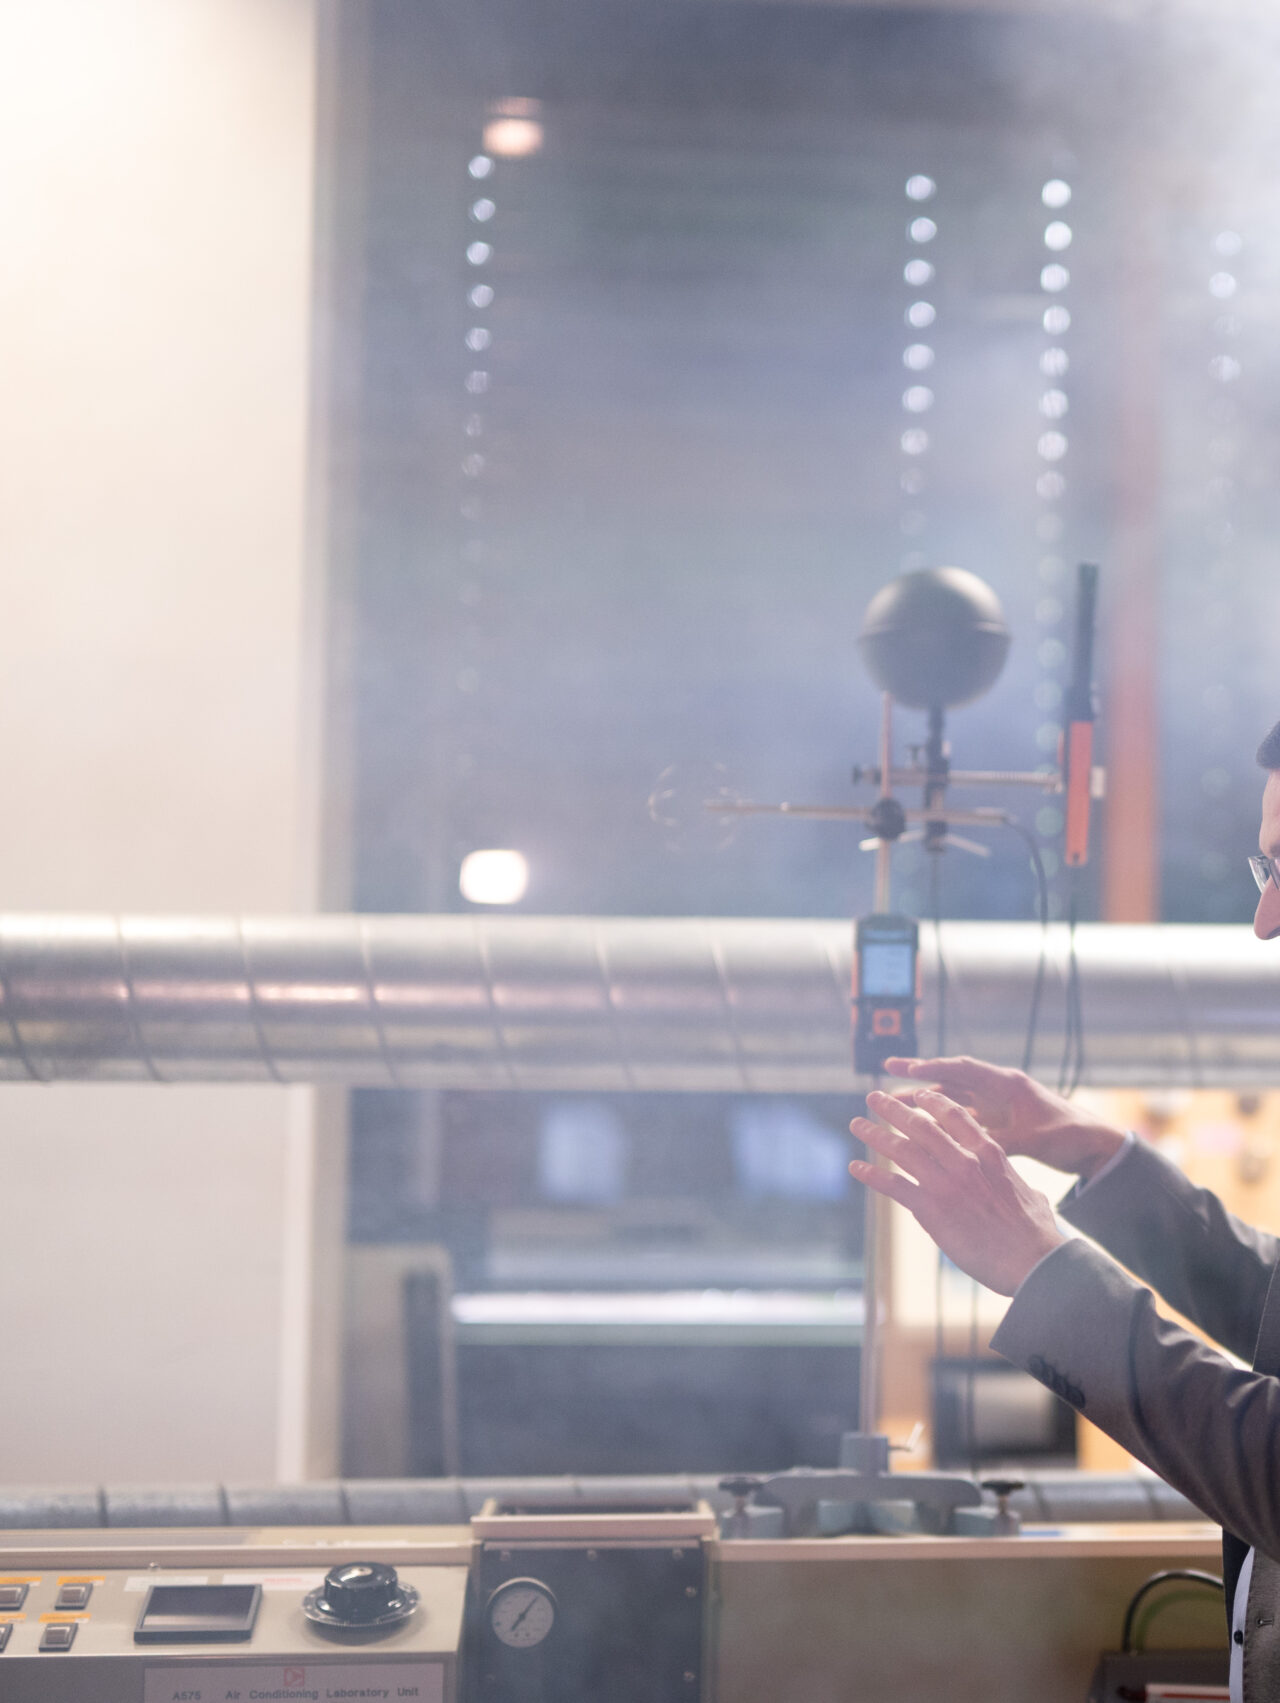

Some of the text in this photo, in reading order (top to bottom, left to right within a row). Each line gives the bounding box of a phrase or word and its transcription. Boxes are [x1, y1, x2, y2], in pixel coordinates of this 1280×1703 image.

[172, 1687, 419, 1701] A575 Air Conditioning Laboratory Unit
